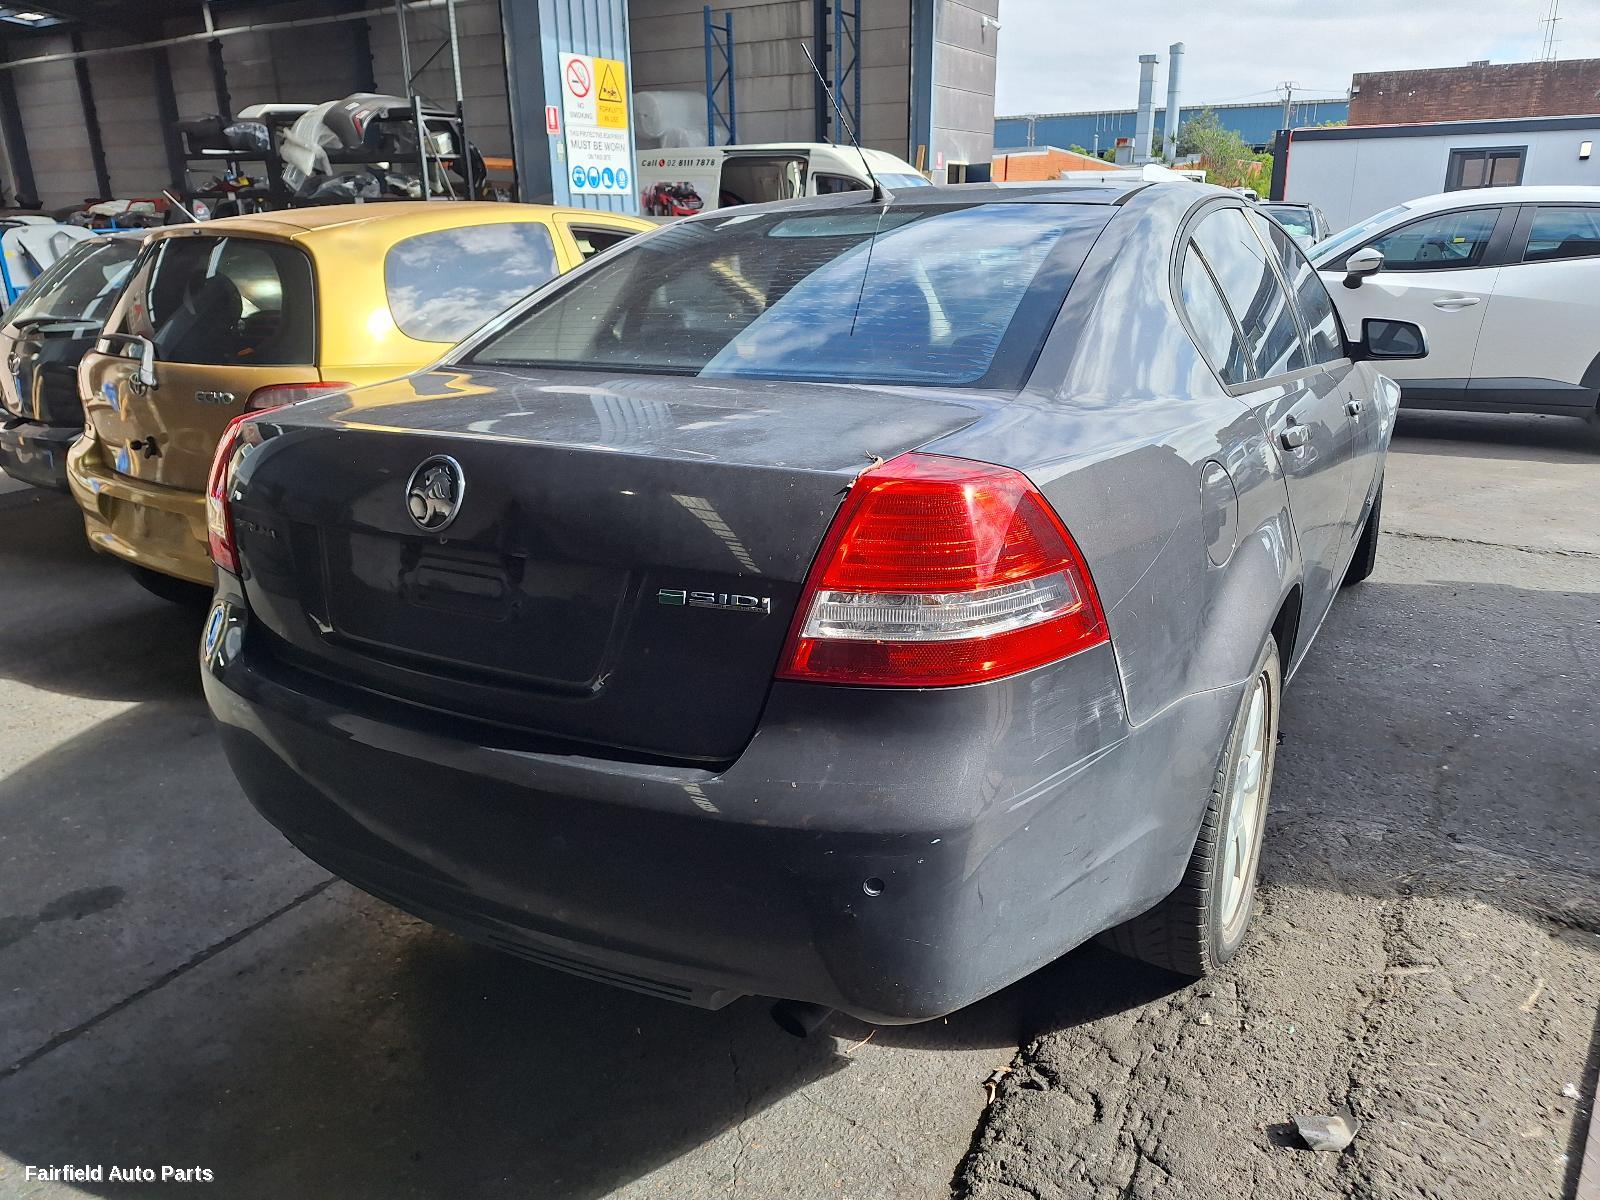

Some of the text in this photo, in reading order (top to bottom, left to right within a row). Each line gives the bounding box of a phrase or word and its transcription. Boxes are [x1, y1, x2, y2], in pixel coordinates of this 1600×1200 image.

[571, 139, 625, 152] MUST BE WORN
[195, 391, 235, 404] ECHO
[688, 591, 770, 614] SIDI
